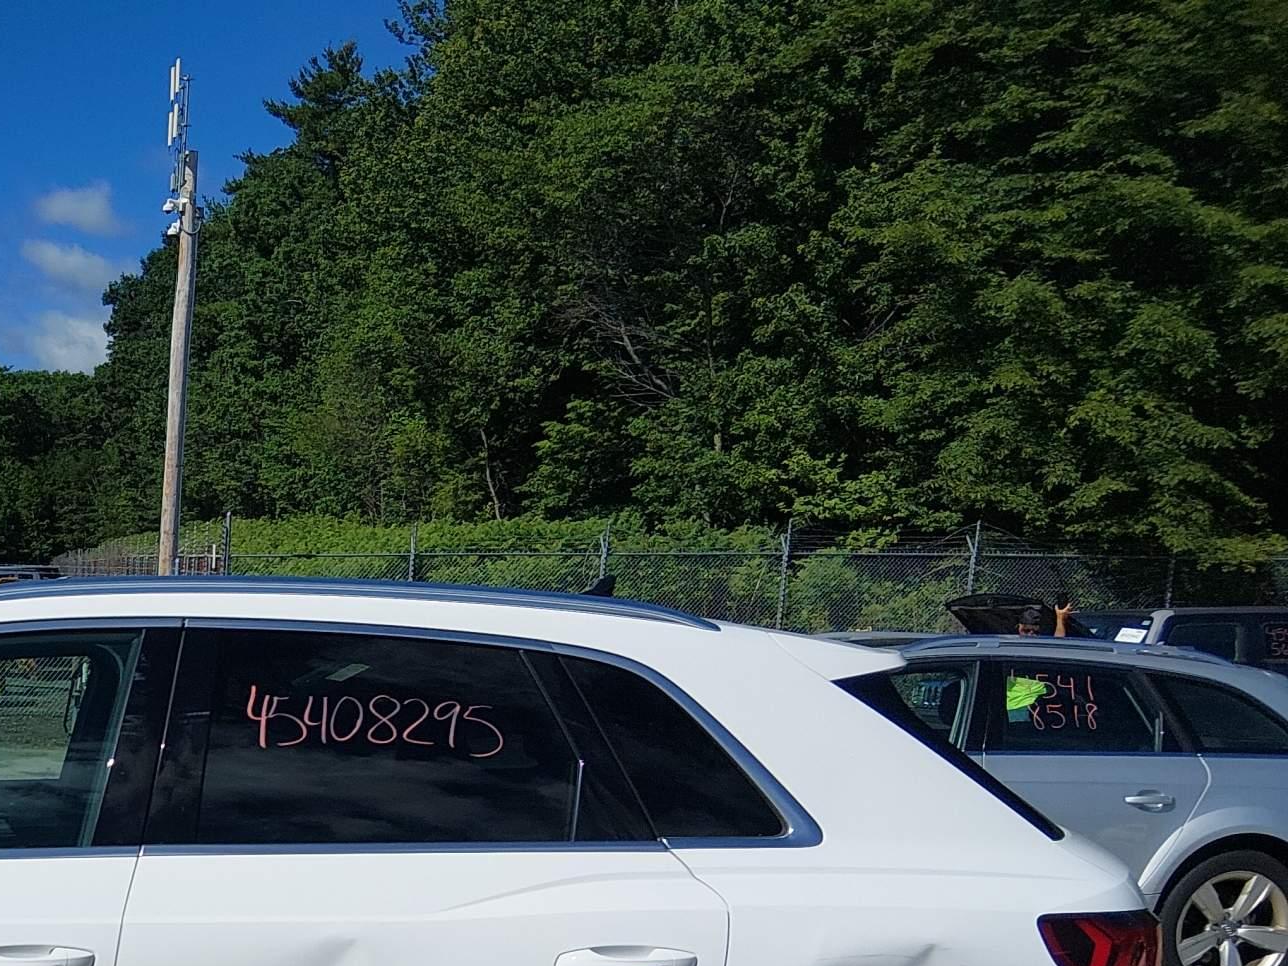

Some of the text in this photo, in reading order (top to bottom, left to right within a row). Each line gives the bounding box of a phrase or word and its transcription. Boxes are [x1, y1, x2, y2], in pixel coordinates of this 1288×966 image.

[1010, 668, 1094, 701] 541
[247, 685, 504, 757] 45408295
[1027, 702, 1098, 730] 8518
